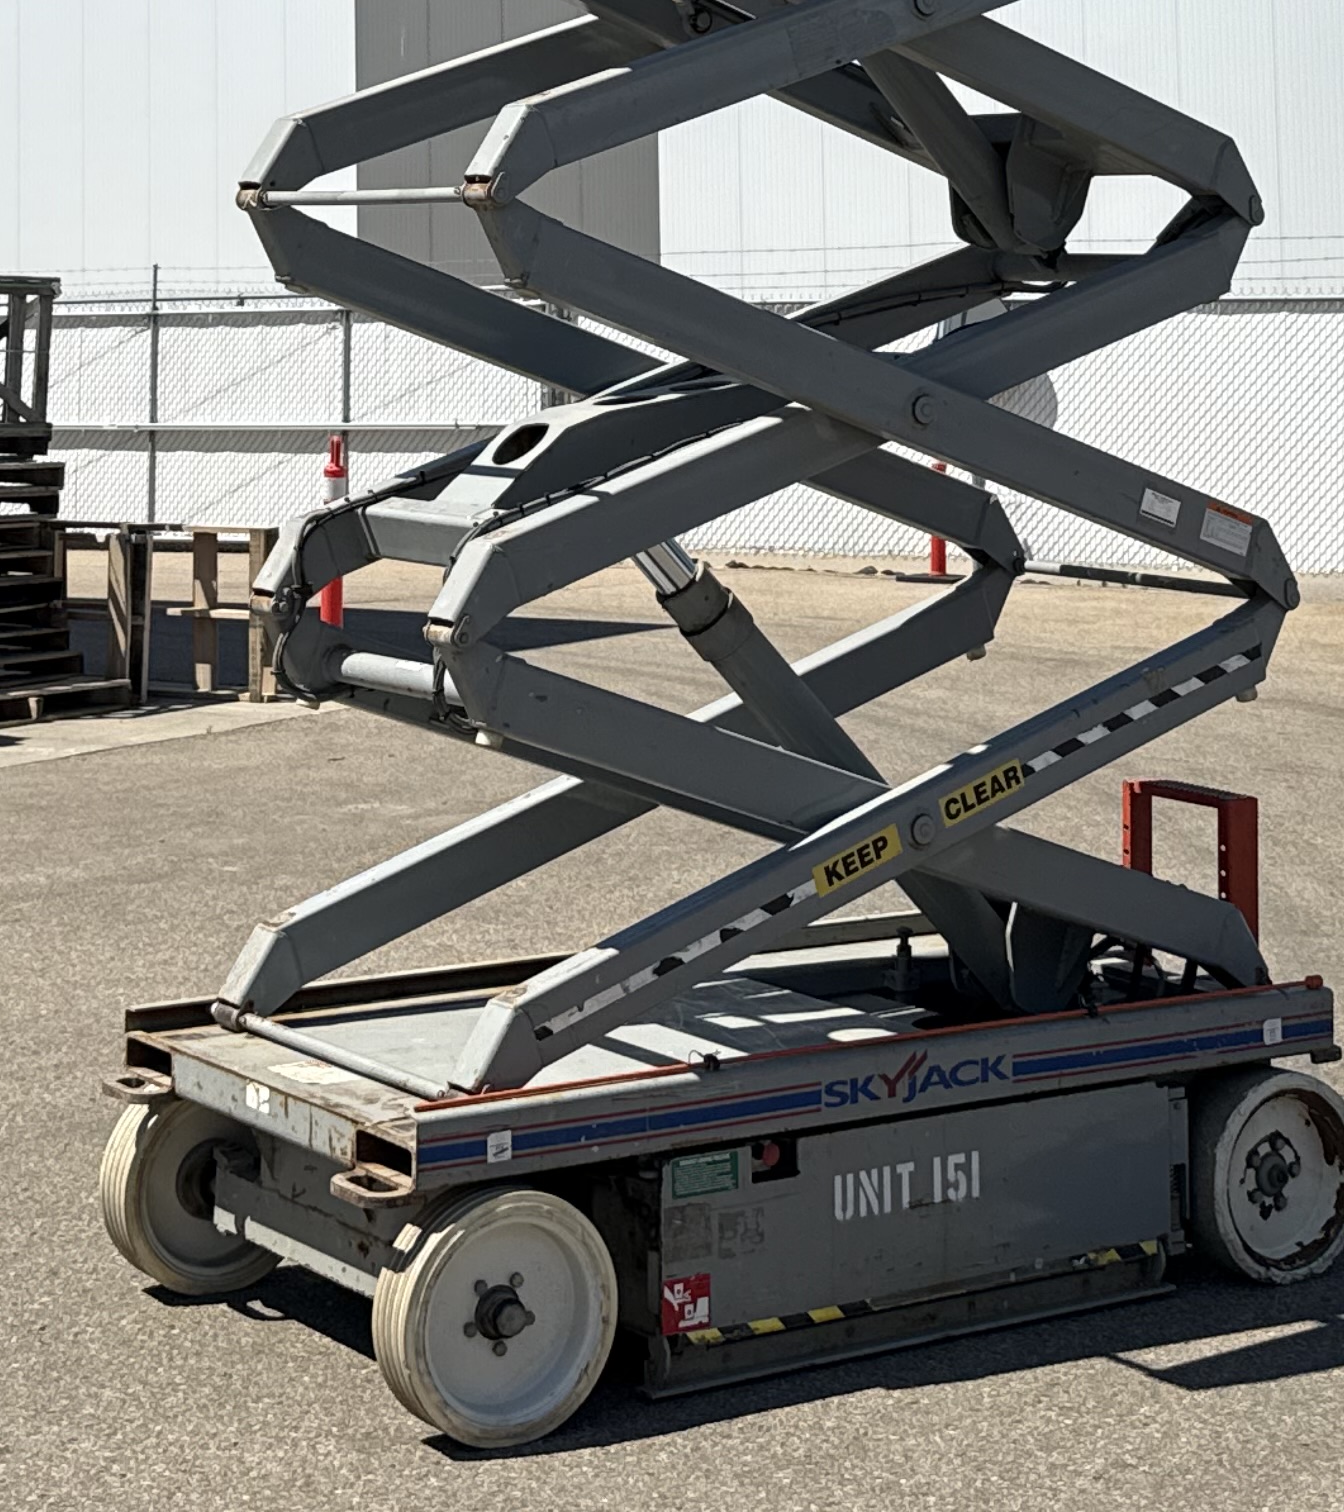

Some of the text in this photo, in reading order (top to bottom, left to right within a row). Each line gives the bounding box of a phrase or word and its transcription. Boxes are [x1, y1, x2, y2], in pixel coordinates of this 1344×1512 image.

[823, 764, 1022, 887] KEEP CLEAR
[824, 1050, 1011, 1107] SKYJACK
[833, 1150, 981, 1221] UNIT 151
